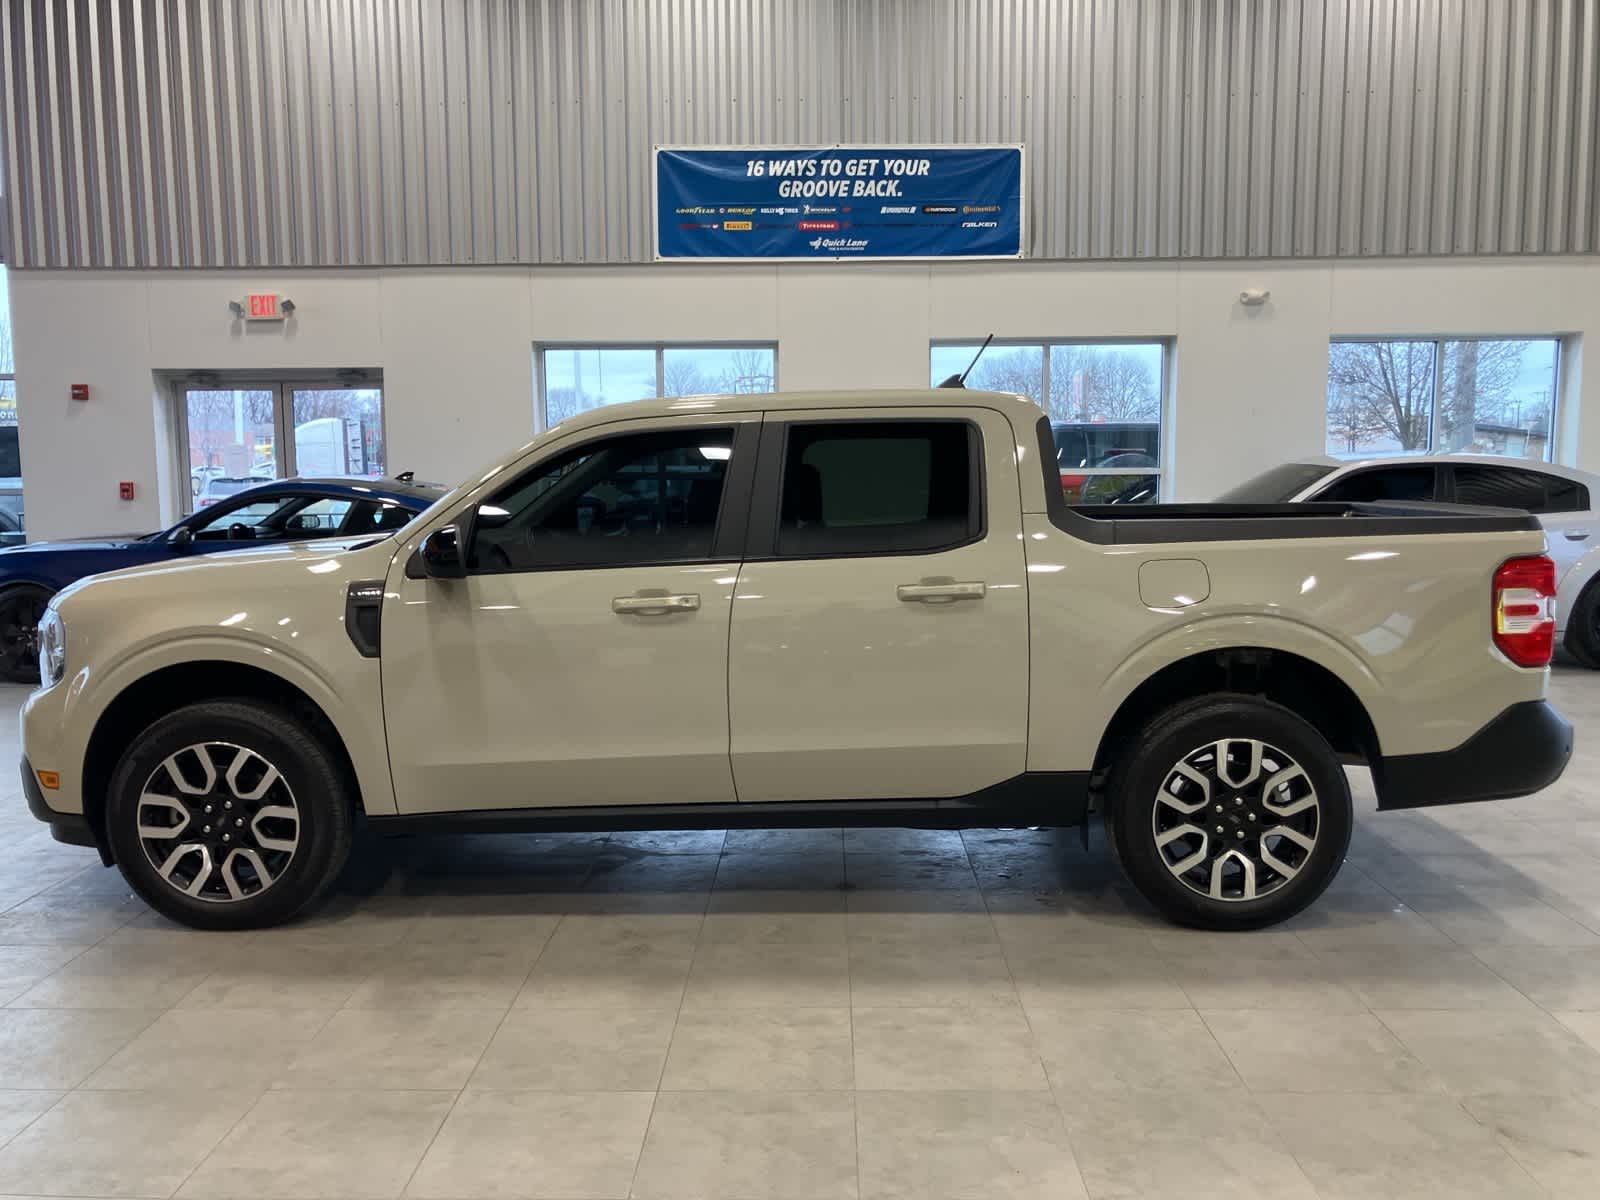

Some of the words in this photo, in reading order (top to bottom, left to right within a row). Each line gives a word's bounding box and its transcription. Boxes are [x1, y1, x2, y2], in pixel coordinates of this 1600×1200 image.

[746, 160, 765, 177] 16
[768, 159, 817, 177] WAYS
[820, 159, 842, 177] TO
[845, 159, 879, 176] GET
[883, 159, 930, 176] YOUR
[778, 180, 850, 198] GROOVE
[852, 179, 903, 197] BACK.
[822, 238, 846, 248] Quick
[846, 238, 869, 247] Lane
[250, 295, 278, 316] EXIT
